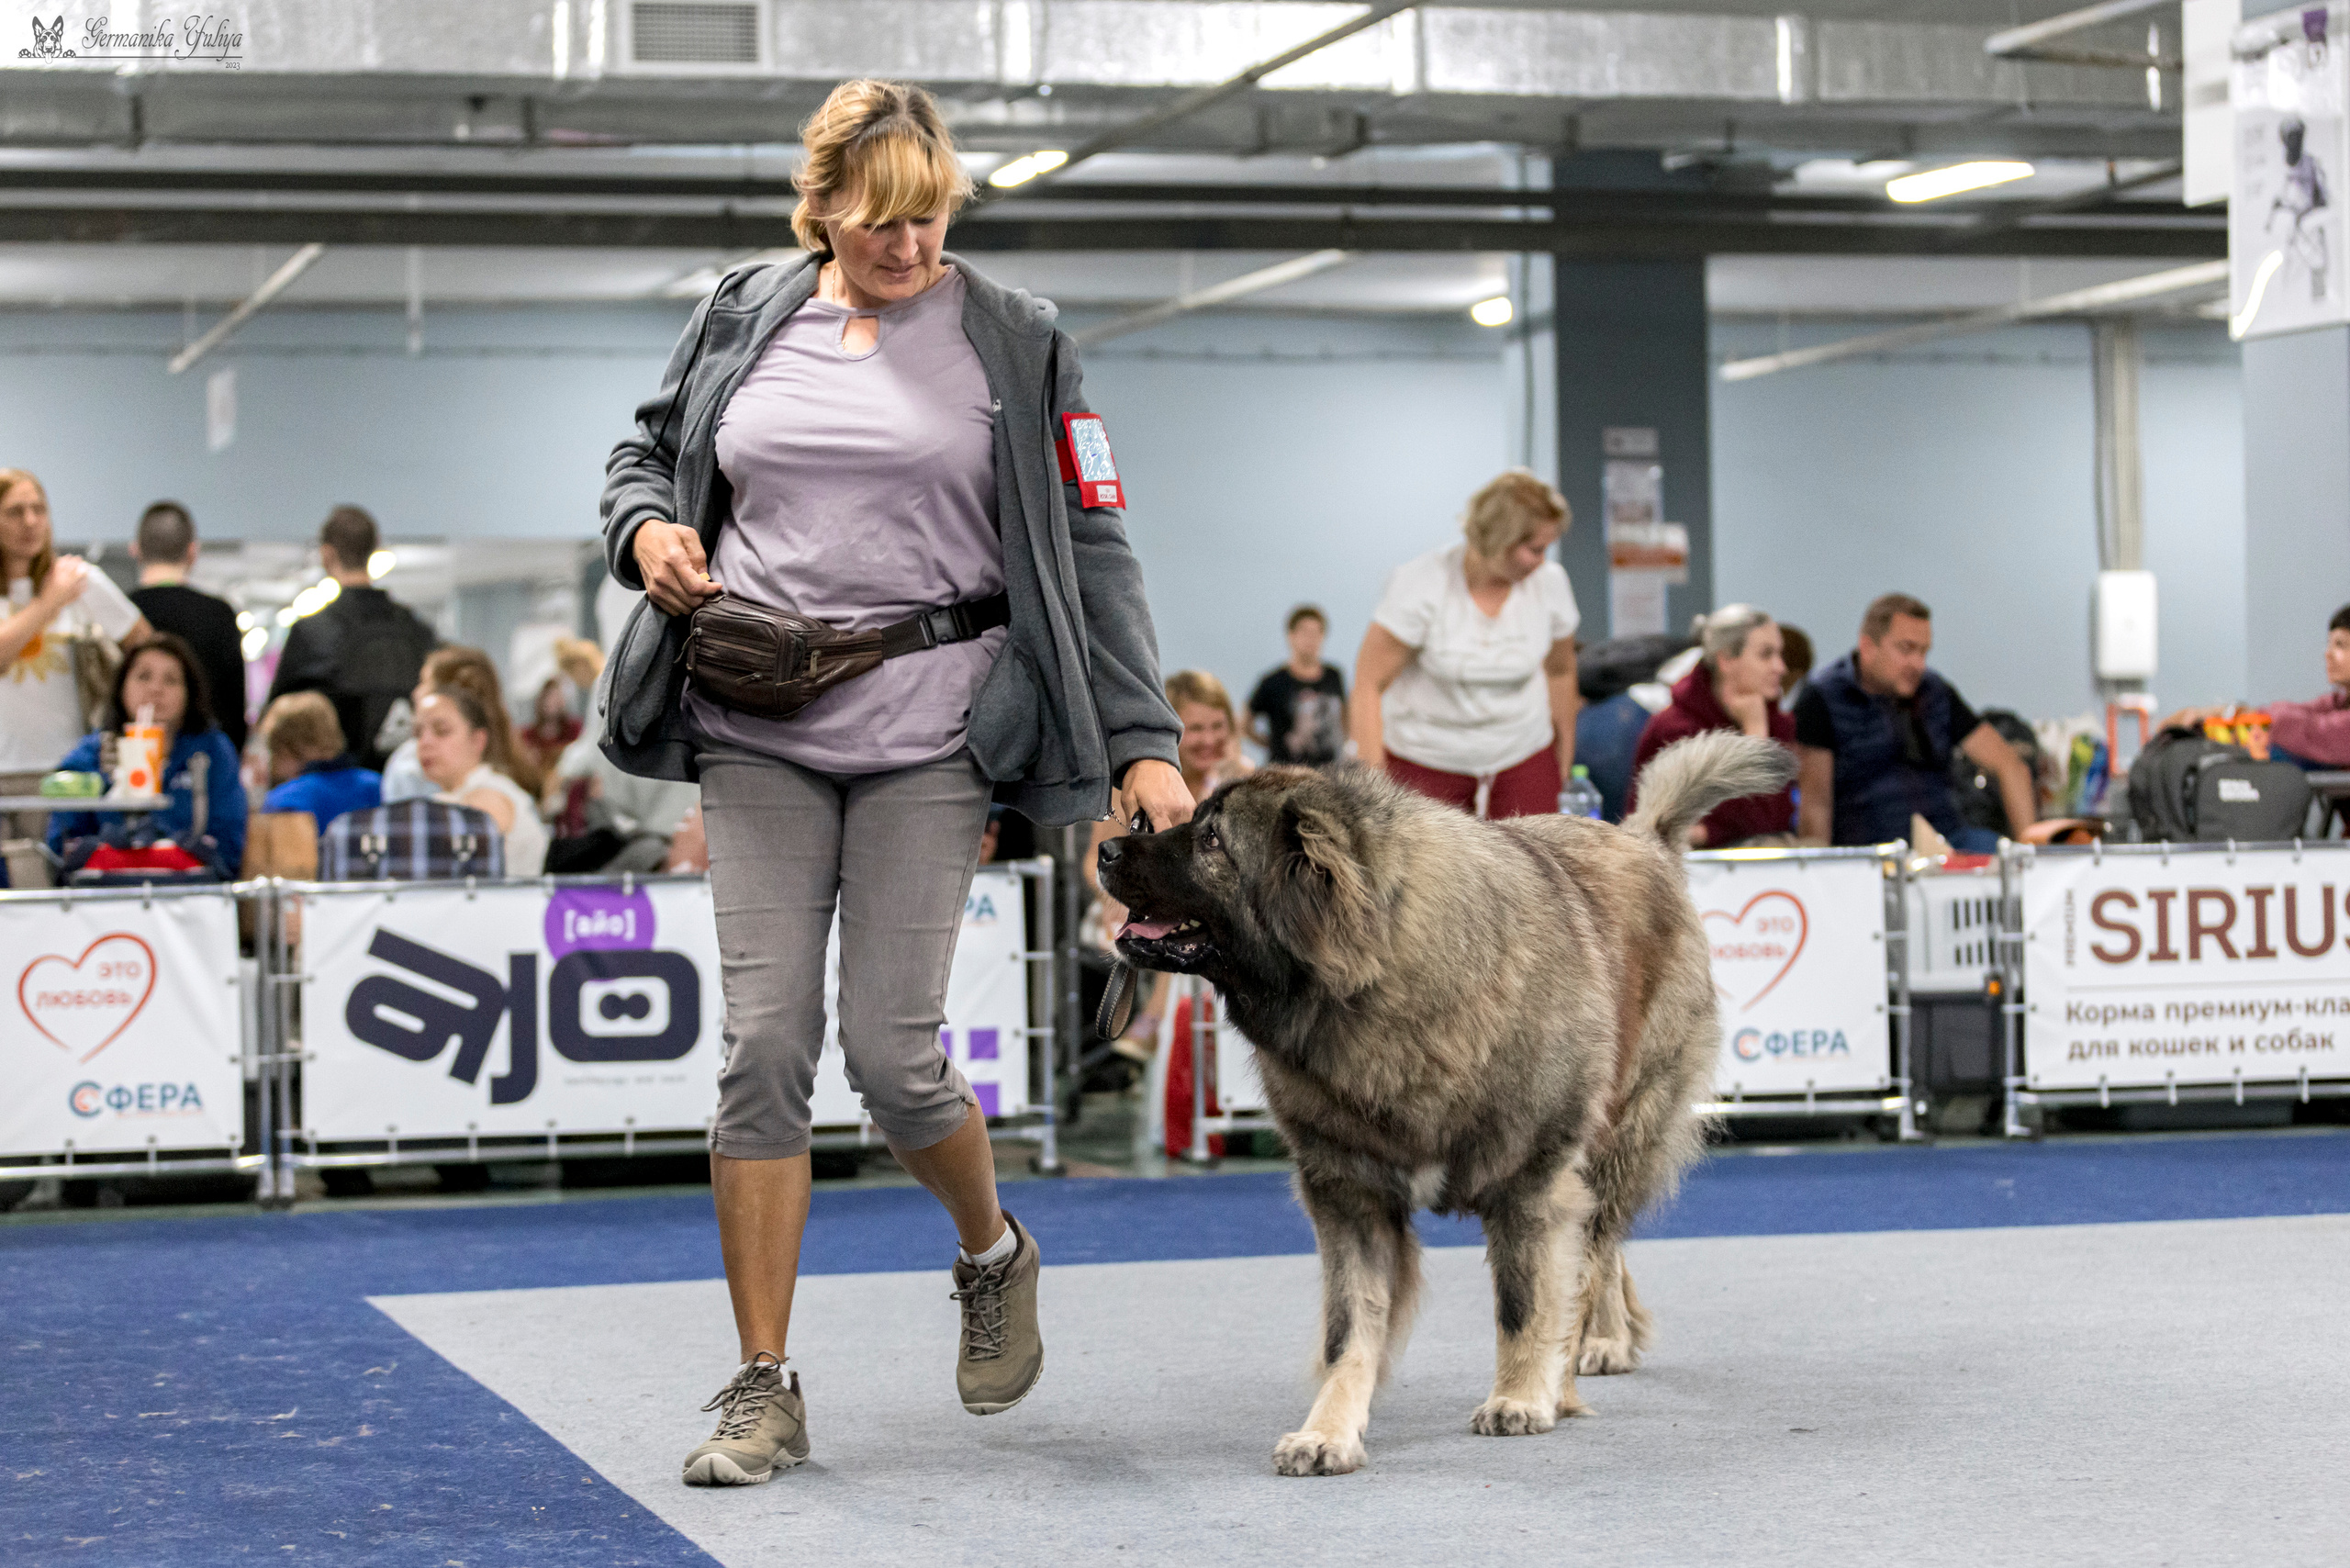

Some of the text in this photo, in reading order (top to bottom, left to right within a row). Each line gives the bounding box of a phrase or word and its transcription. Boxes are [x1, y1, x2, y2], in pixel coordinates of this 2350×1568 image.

[1757, 917, 1794, 933] ЭТО
[2090, 885, 2350, 964] SIRIU
[99, 962, 141, 979] ЭТО
[38, 991, 132, 1008] ЛЮБОВЬ
[2066, 1000, 2155, 1028] Корма
[1732, 1027, 1850, 1062] СФЕРА
[2068, 1027, 2334, 1060] для кошек и собак
[69, 1081, 202, 1117] СФЕРА
